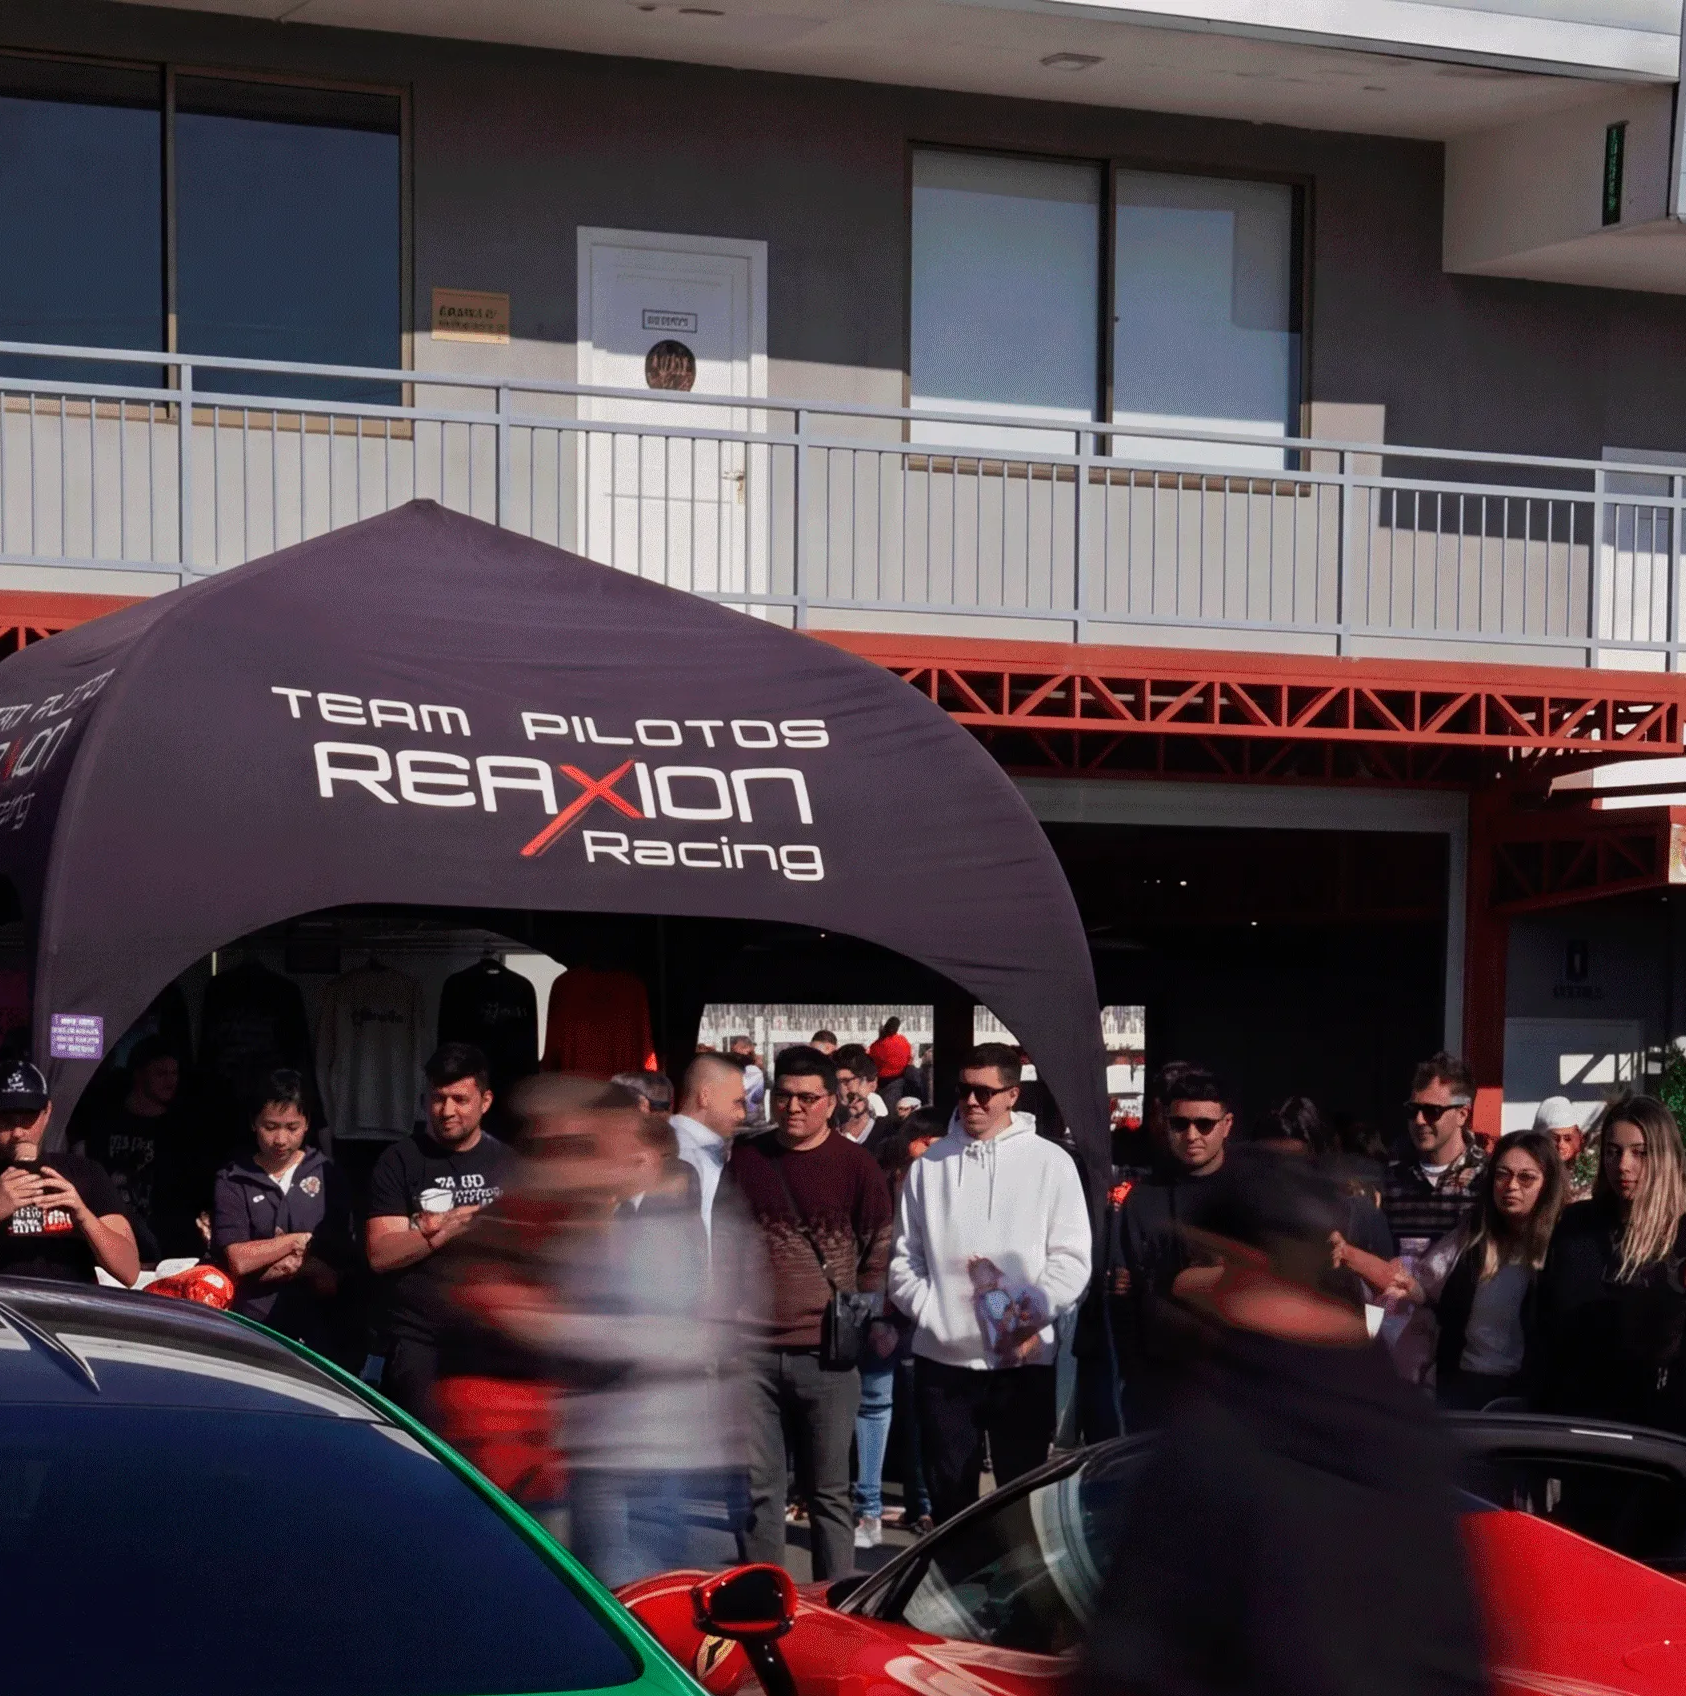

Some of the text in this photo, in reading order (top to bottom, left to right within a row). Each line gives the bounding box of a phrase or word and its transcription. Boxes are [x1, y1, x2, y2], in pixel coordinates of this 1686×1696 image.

[271, 686, 830, 749] TEAM PILOTOS
[313, 741, 814, 857] REAXION
[582, 829, 825, 882] Racing
